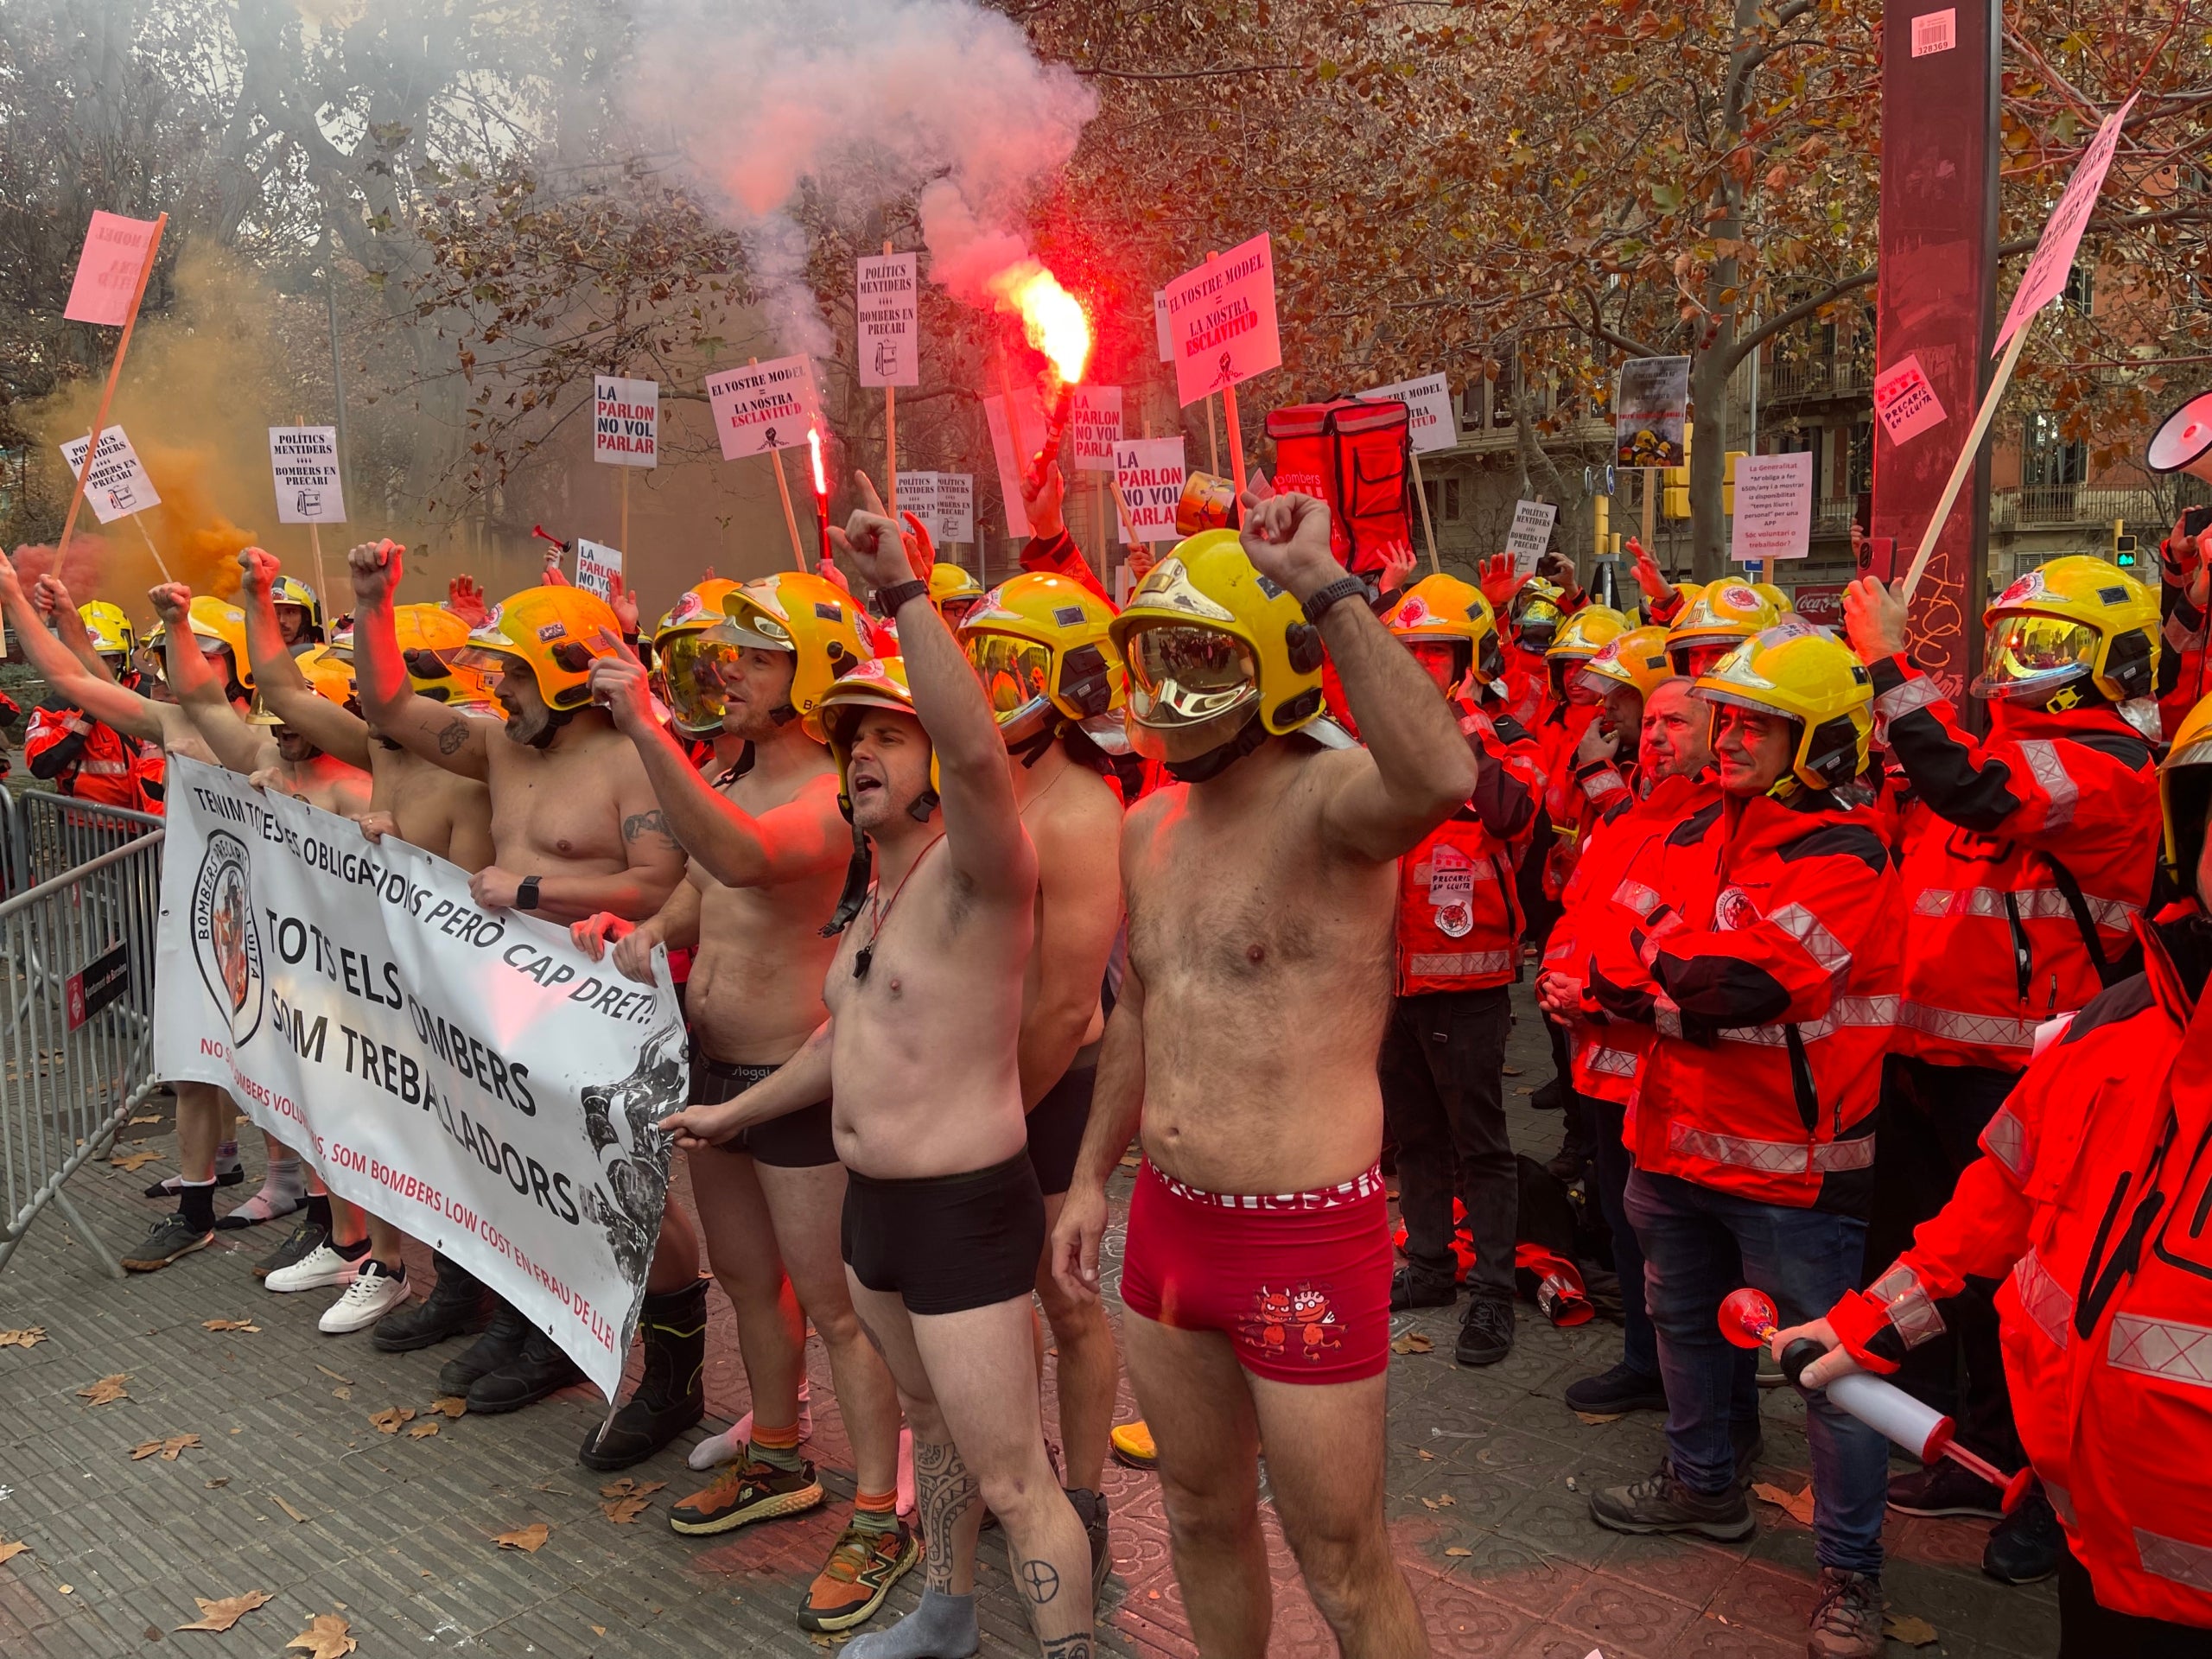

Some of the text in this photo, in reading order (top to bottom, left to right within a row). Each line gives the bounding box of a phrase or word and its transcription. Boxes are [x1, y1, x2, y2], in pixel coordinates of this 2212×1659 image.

[865, 264, 906, 280] POLÍTICS
[860, 278, 912, 295] MENTIDERS
[1169, 253, 1264, 315] EL VOSTRE MODEL
[860, 308, 914, 322] BOMBERS EN
[1190, 296, 1249, 337] LA NOSTRA
[868, 322, 906, 335] PRECARI
[1185, 310, 1258, 357] ESCLAVITUD
[711, 365, 806, 397] EL VOSTRE MODEL
[598, 385, 617, 401] LA
[1408, 383, 1442, 399] MODEL
[734, 392, 793, 415] LA NOSTRA
[1074, 395, 1089, 409] LA
[1885, 386, 1927, 422] PRECARIS
[598, 401, 654, 422] PARLON
[731, 402, 802, 428] ESCLAVITUD
[1075, 410, 1120, 425] PARLON
[1410, 406, 1429, 418] TRA
[1891, 416, 1902, 429] EN
[1905, 394, 1932, 418] LLUITA
[598, 417, 653, 437] NO VOL
[1076, 426, 1120, 442] NO VOL
[274, 445, 332, 454] MENTIDERS
[597, 434, 654, 454] PARLAR
[1077, 442, 1113, 457] PARLA
[1117, 451, 1139, 469] LA
[86, 458, 137, 481] OMBERS EN
[275, 466, 336, 476] BOMBERS EN
[1118, 467, 1183, 487] PARLON
[1274, 471, 1321, 486] bombers
[92, 469, 133, 489] PRECARI
[285, 476, 328, 486] PRECARI
[1755, 492, 1796, 500] disponibilitat
[1516, 515, 1550, 527] MENTIDERS
[581, 546, 594, 561] LA
[579, 571, 594, 587] NO
[194, 787, 245, 823] TENIM
[424, 899, 505, 948] PERÒ
[503, 944, 575, 988] CAP
[198, 855, 218, 939] BOMBERS
[266, 907, 537, 1117] TOTS ELS OMBERS
[271, 988, 328, 1063] SOM
[200, 1038, 223, 1058] NO
[234, 1069, 270, 1107] OMBERS
[331, 1143, 366, 1174] SOM
[371, 1160, 442, 1211] BOMBERS
[445, 1197, 478, 1233] LOW
[480, 1220, 511, 1259] COST
[513, 1246, 532, 1276] EN
[533, 1263, 570, 1306] FRAU
[574, 1292, 590, 1325] DE
[591, 1310, 615, 1354] LLEI
